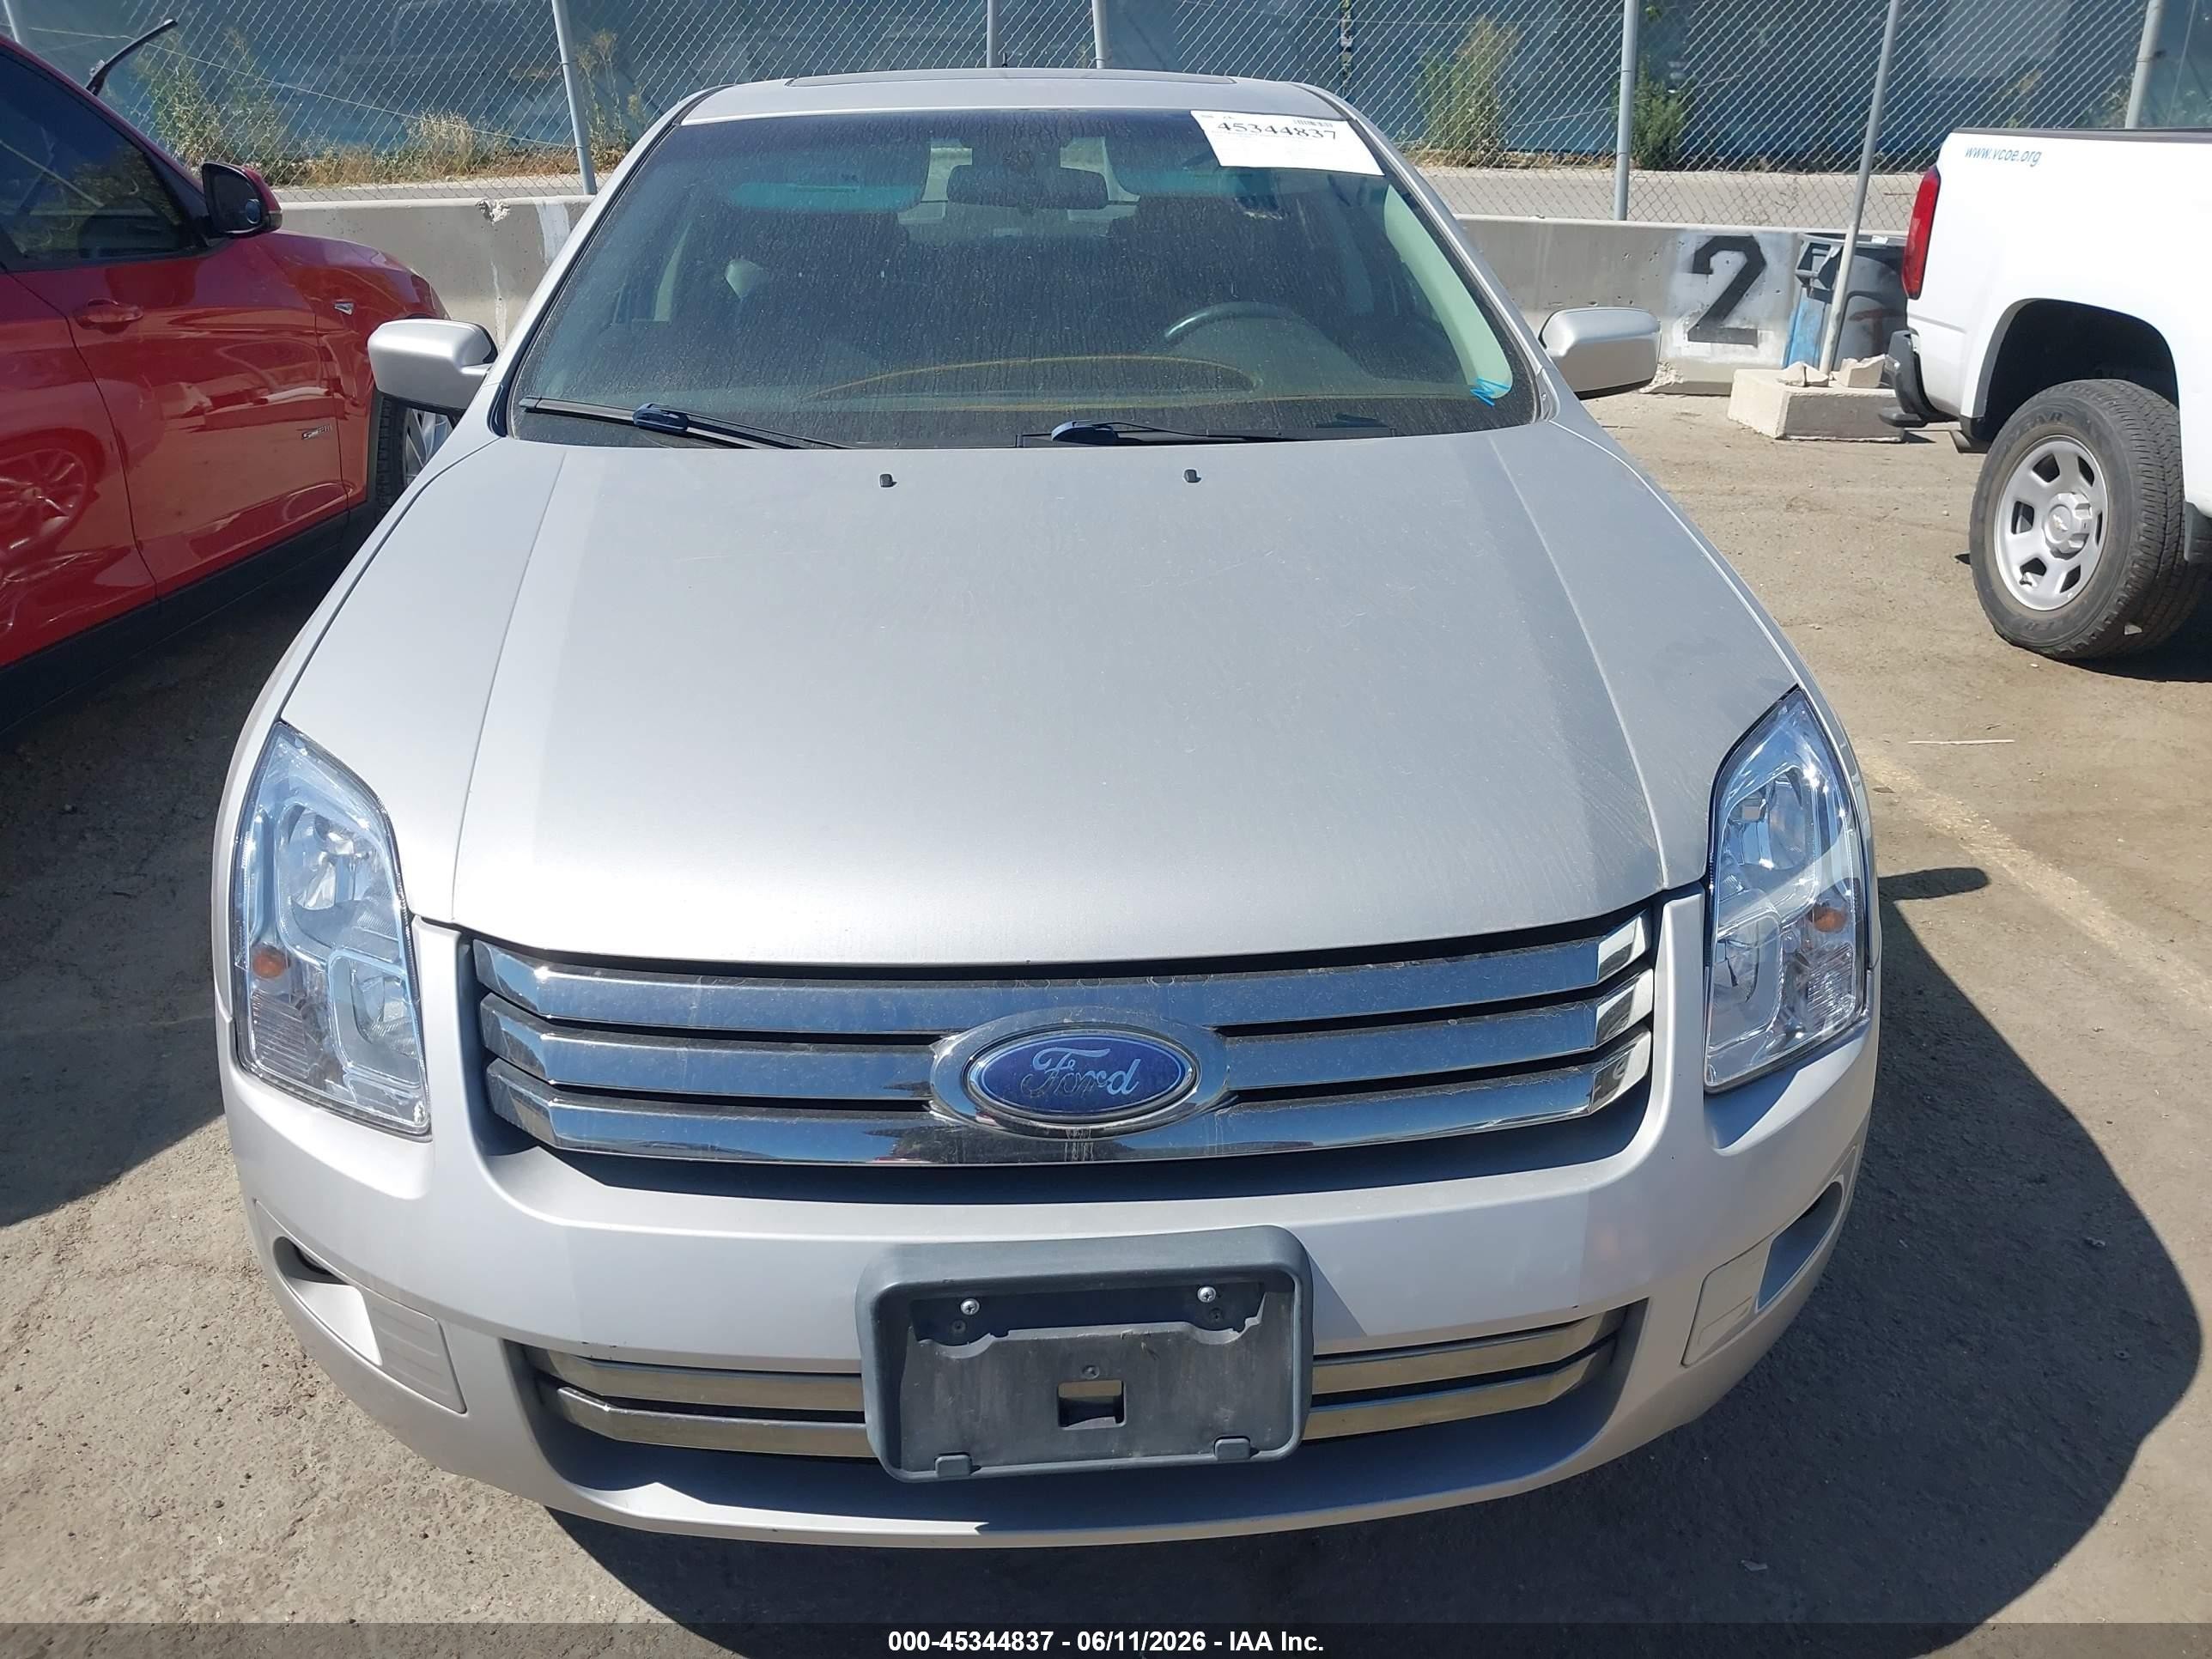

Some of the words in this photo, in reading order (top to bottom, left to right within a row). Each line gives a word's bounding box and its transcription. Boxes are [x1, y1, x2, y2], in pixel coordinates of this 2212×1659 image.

[1217, 122, 1336, 140] 45344837
[1964, 147, 2042, 167] www.vcoe.org
[1687, 235, 1767, 347] 2
[1020, 1047, 1141, 1097] Ford
